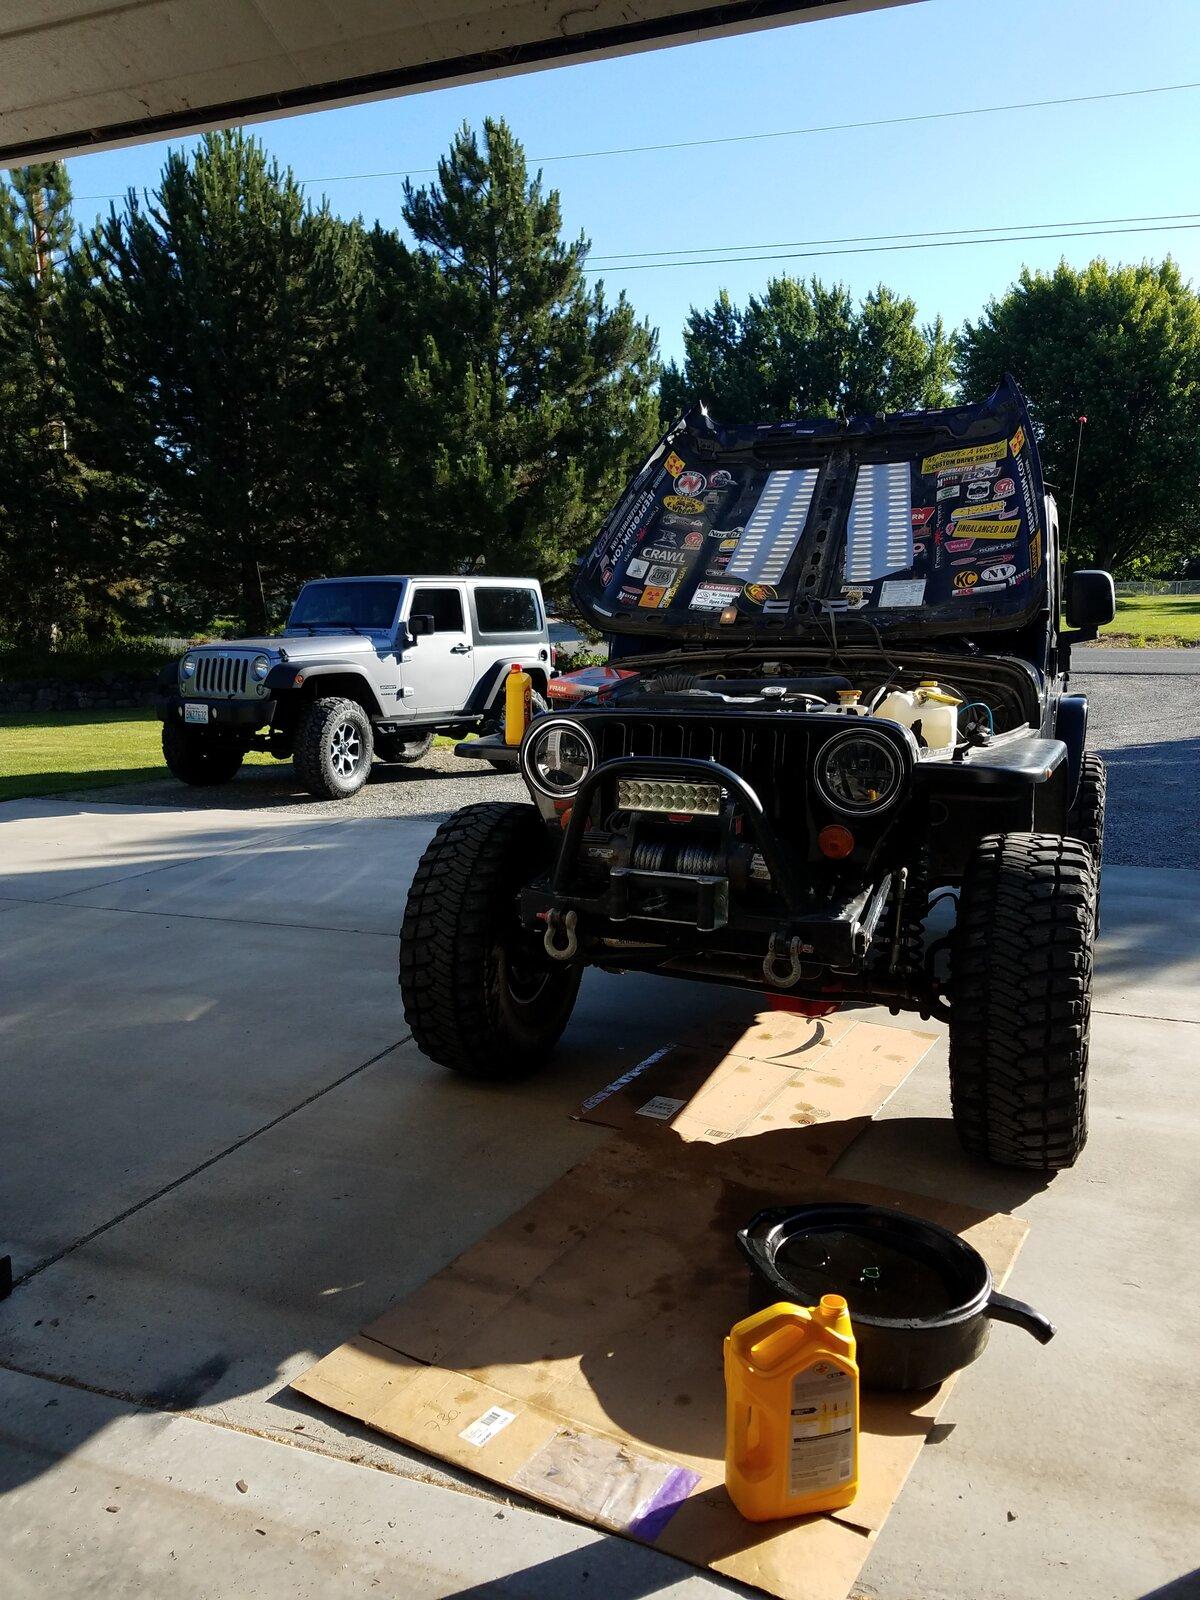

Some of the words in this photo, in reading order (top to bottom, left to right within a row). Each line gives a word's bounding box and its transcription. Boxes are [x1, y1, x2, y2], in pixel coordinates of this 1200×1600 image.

[931, 459, 956, 469] CUSTOM
[956, 456, 975, 464] DRIVE
[975, 451, 998, 461] SHAFTS
[611, 490, 656, 566] JEEPFORUM.COM
[956, 524, 999, 534] UNBALANCED
[1000, 524, 1017, 533] LOAD
[642, 547, 686, 563] CRAWL
[955, 572, 976, 587] KC
[703, 584, 737, 592] DANGER
[549, 684, 567, 692] FRAM
